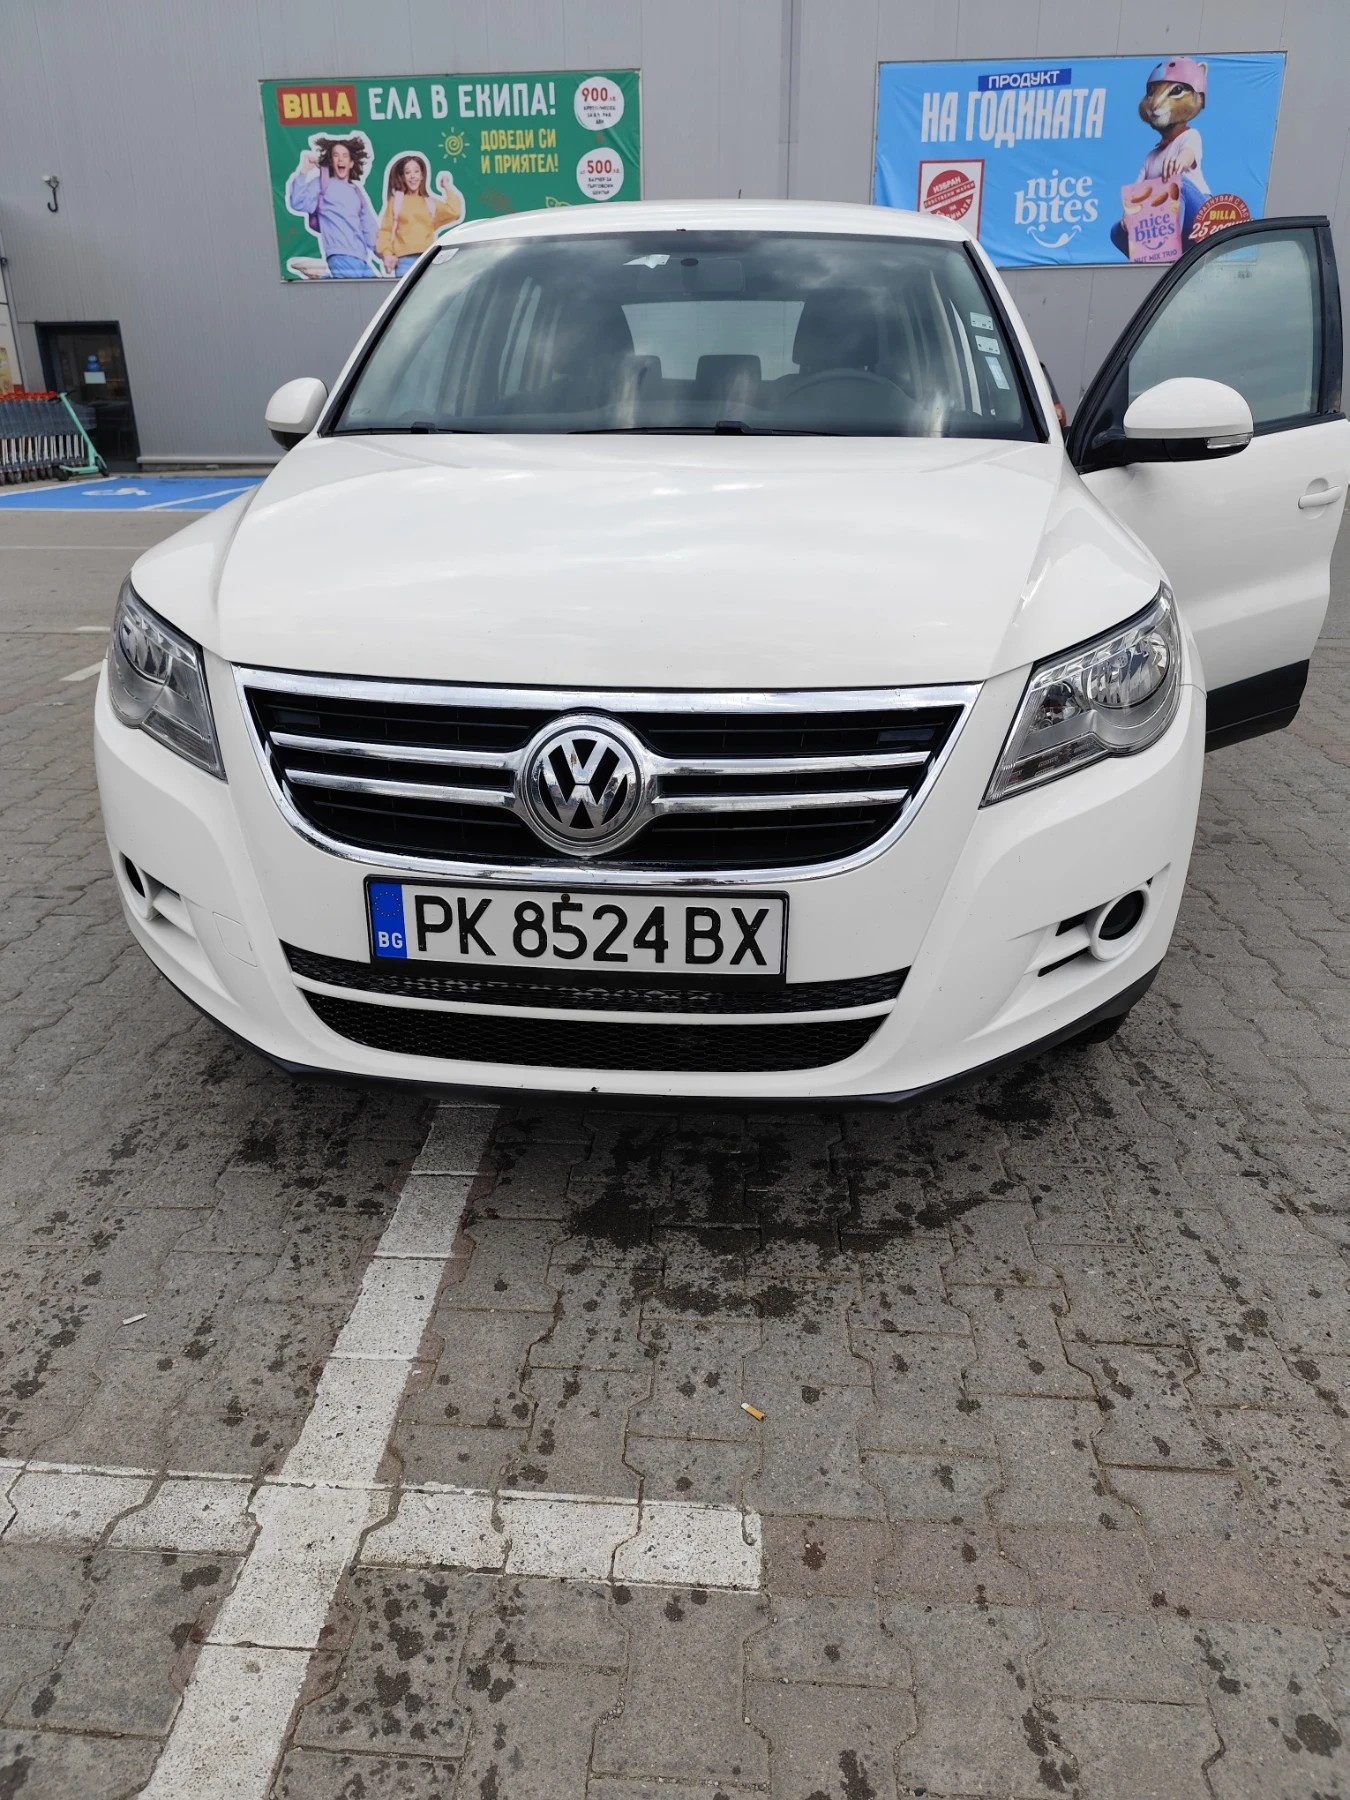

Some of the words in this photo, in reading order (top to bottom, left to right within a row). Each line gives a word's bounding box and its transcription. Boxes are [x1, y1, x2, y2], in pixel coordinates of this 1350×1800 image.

[988, 70, 1060, 89] ПРОДУКТ
[368, 86, 422, 120] ЕЛА
[431, 84, 448, 119] В
[458, 82, 556, 117] ЕКИПА!
[582, 87, 608, 102] 900
[282, 92, 353, 118] BILLA
[921, 92, 958, 142] НА
[965, 88, 1106, 148] ГОДИНАТА
[481, 129, 534, 151] ДОВЕДИ
[539, 128, 556, 148] СИ
[481, 155, 491, 174] И
[495, 153, 559, 174] ПРИЯТЕЛ!
[587, 159, 612, 174] 500
[932, 176, 962, 193] ИЗБРАН
[1025, 168, 1093, 199] nice
[1014, 190, 1099, 230] bites
[1196, 195, 1234, 221] ПРАЗНУВАЙ
[1239, 203, 1249, 218] НАС
[1209, 210, 1236, 220] BILLA
[1139, 213, 1170, 229] nice
[1188, 220, 1211, 240] 25
[1134, 223, 1175, 242] bites
[1149, 253, 1161, 261] MIX
[1162, 249, 1178, 258] TRIO
[378, 930, 403, 949] BG
[513, 900, 669, 963] 8524
